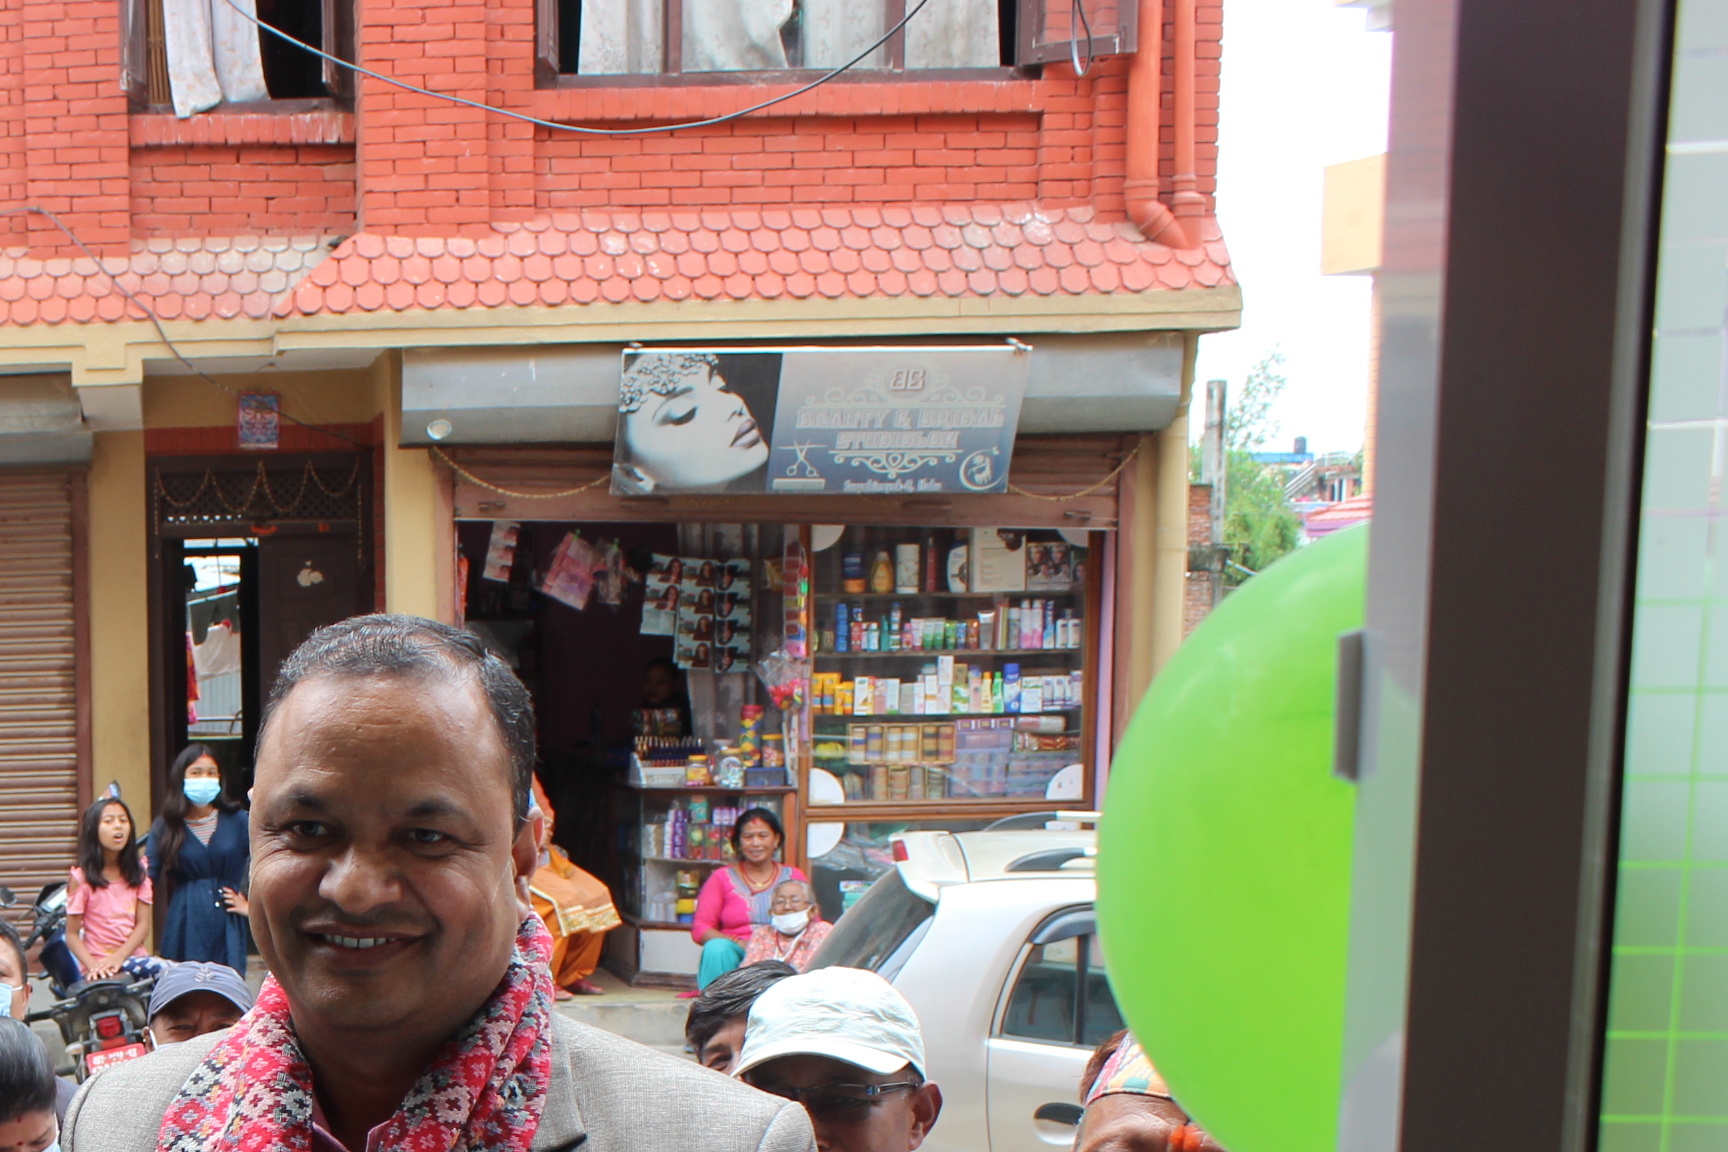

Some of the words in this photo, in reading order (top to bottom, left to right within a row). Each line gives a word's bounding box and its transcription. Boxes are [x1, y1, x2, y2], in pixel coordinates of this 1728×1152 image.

[796, 408, 891, 429] BEAUTY
[893, 408, 912, 429] &
[917, 407, 1004, 429] BRIDAL
